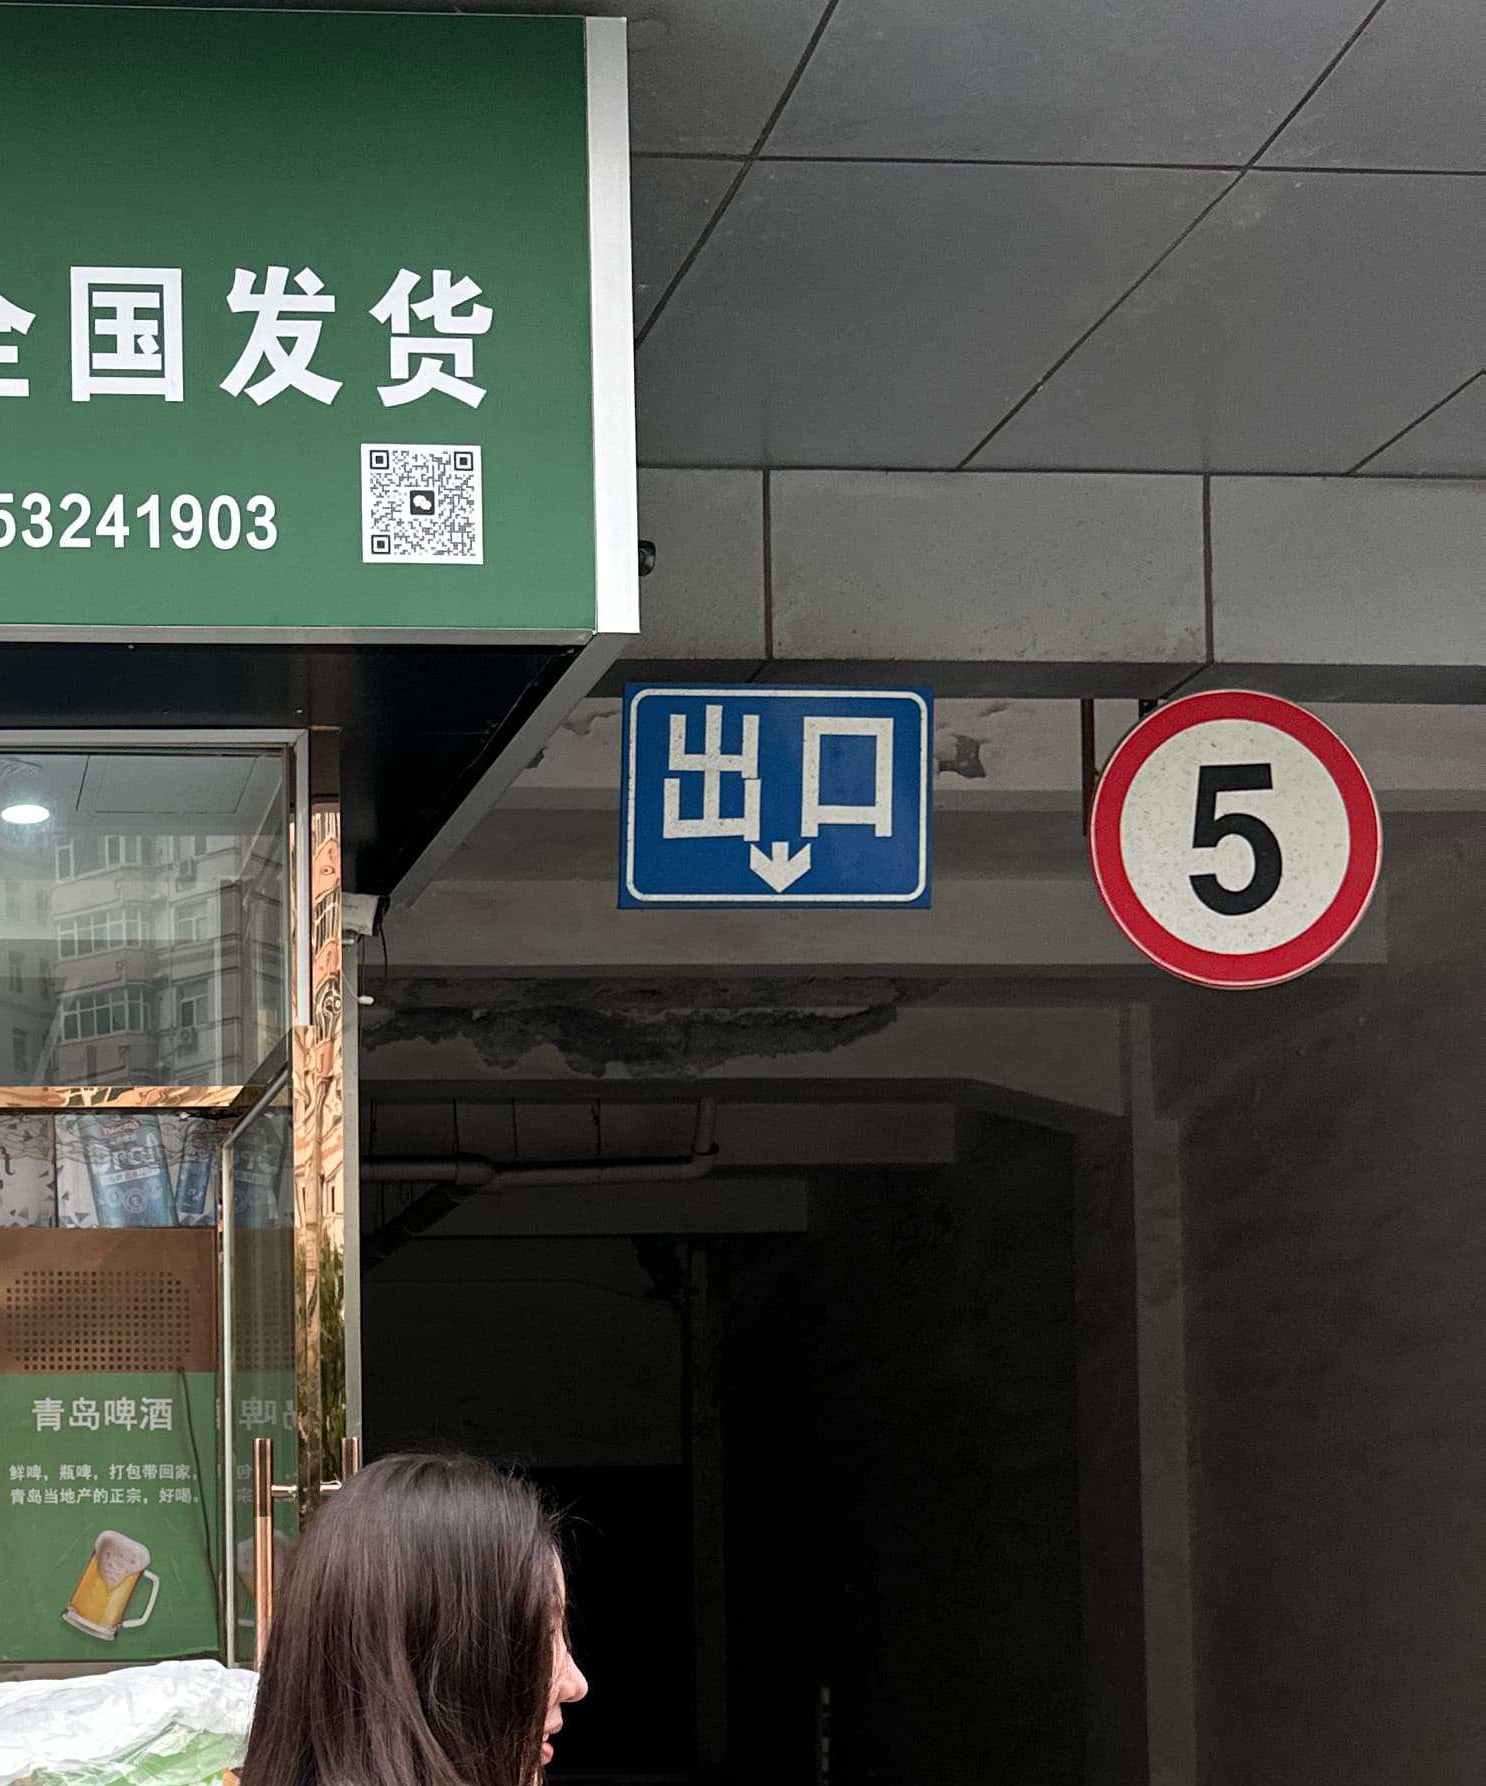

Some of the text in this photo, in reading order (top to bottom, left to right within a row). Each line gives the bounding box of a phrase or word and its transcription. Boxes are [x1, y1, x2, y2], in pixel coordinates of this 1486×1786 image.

[662, 704, 895, 843] 出口
[1188, 762, 1284, 917] 5
[31, 1396, 174, 1432] 青岛啤酒
